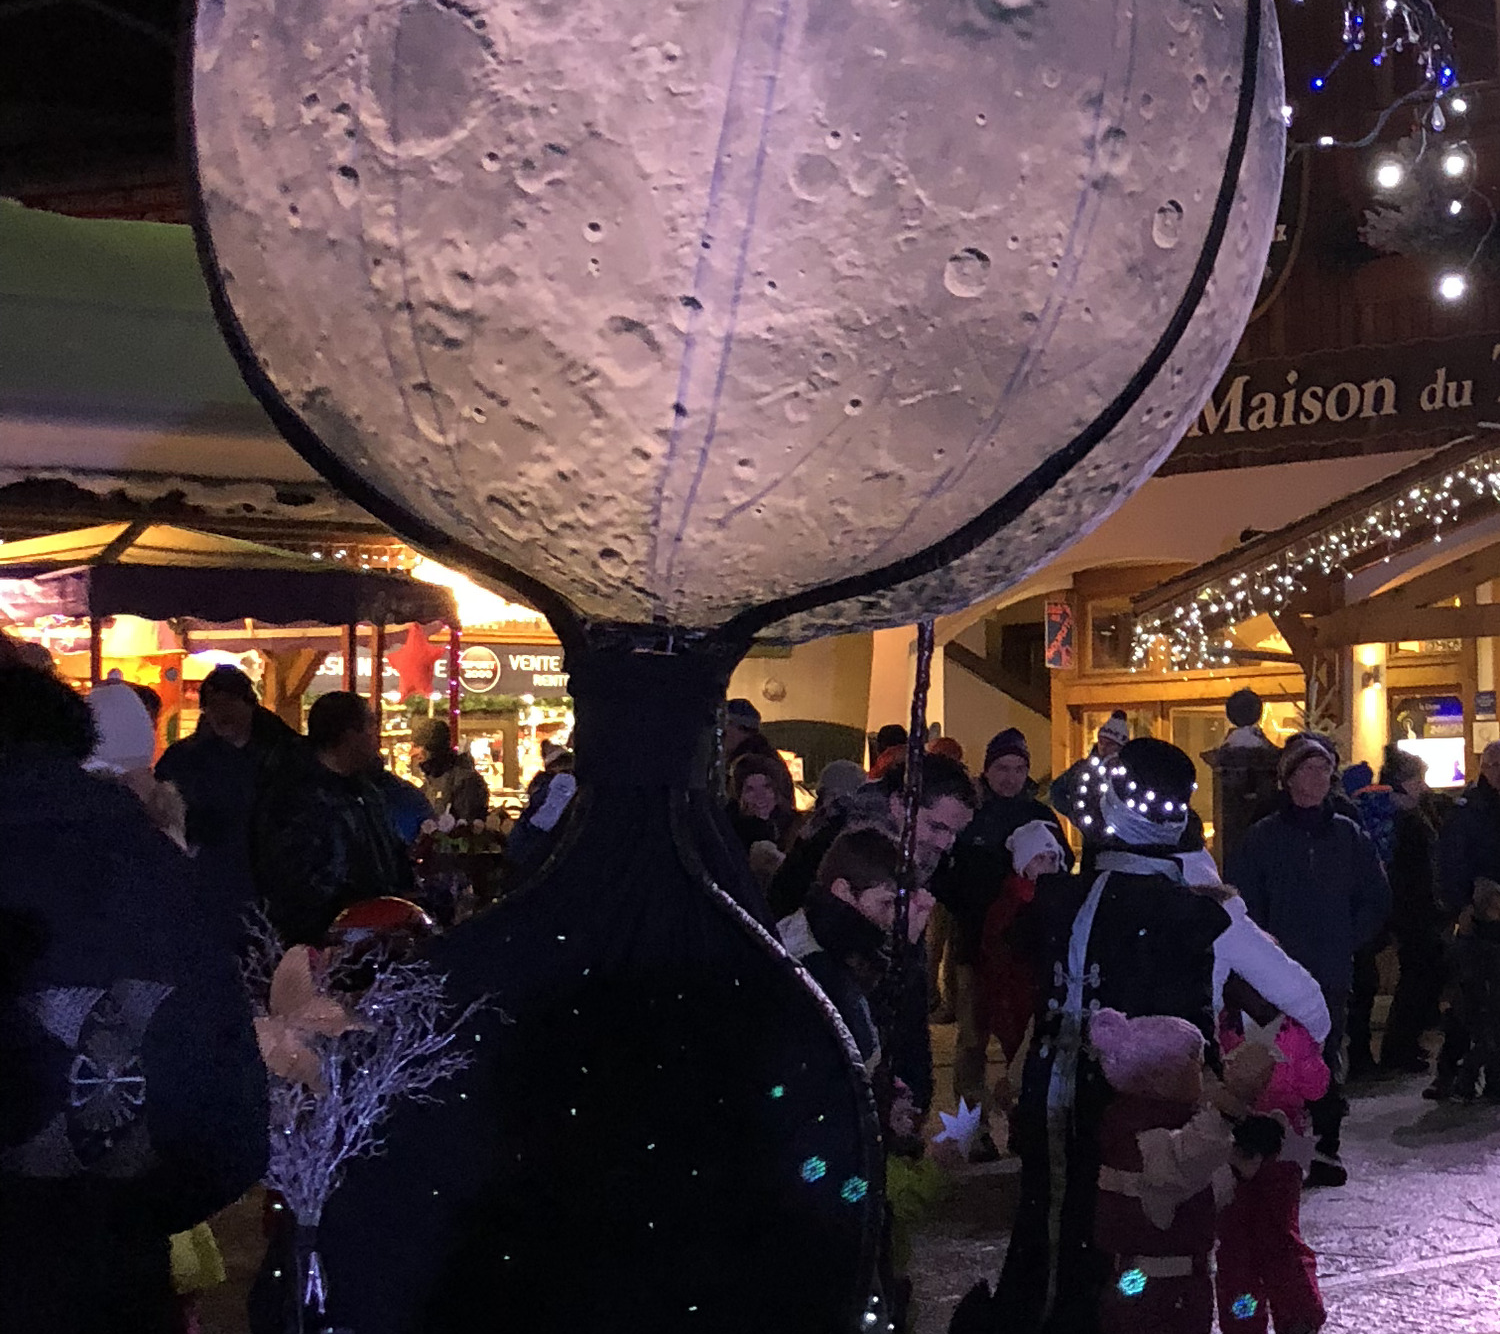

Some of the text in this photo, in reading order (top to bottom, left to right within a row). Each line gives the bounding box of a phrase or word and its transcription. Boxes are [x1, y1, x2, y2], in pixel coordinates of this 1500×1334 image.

[1187, 370, 1397, 437] Maison
[1420, 367, 1473, 411] du
[508, 654, 561, 672] VENTE
